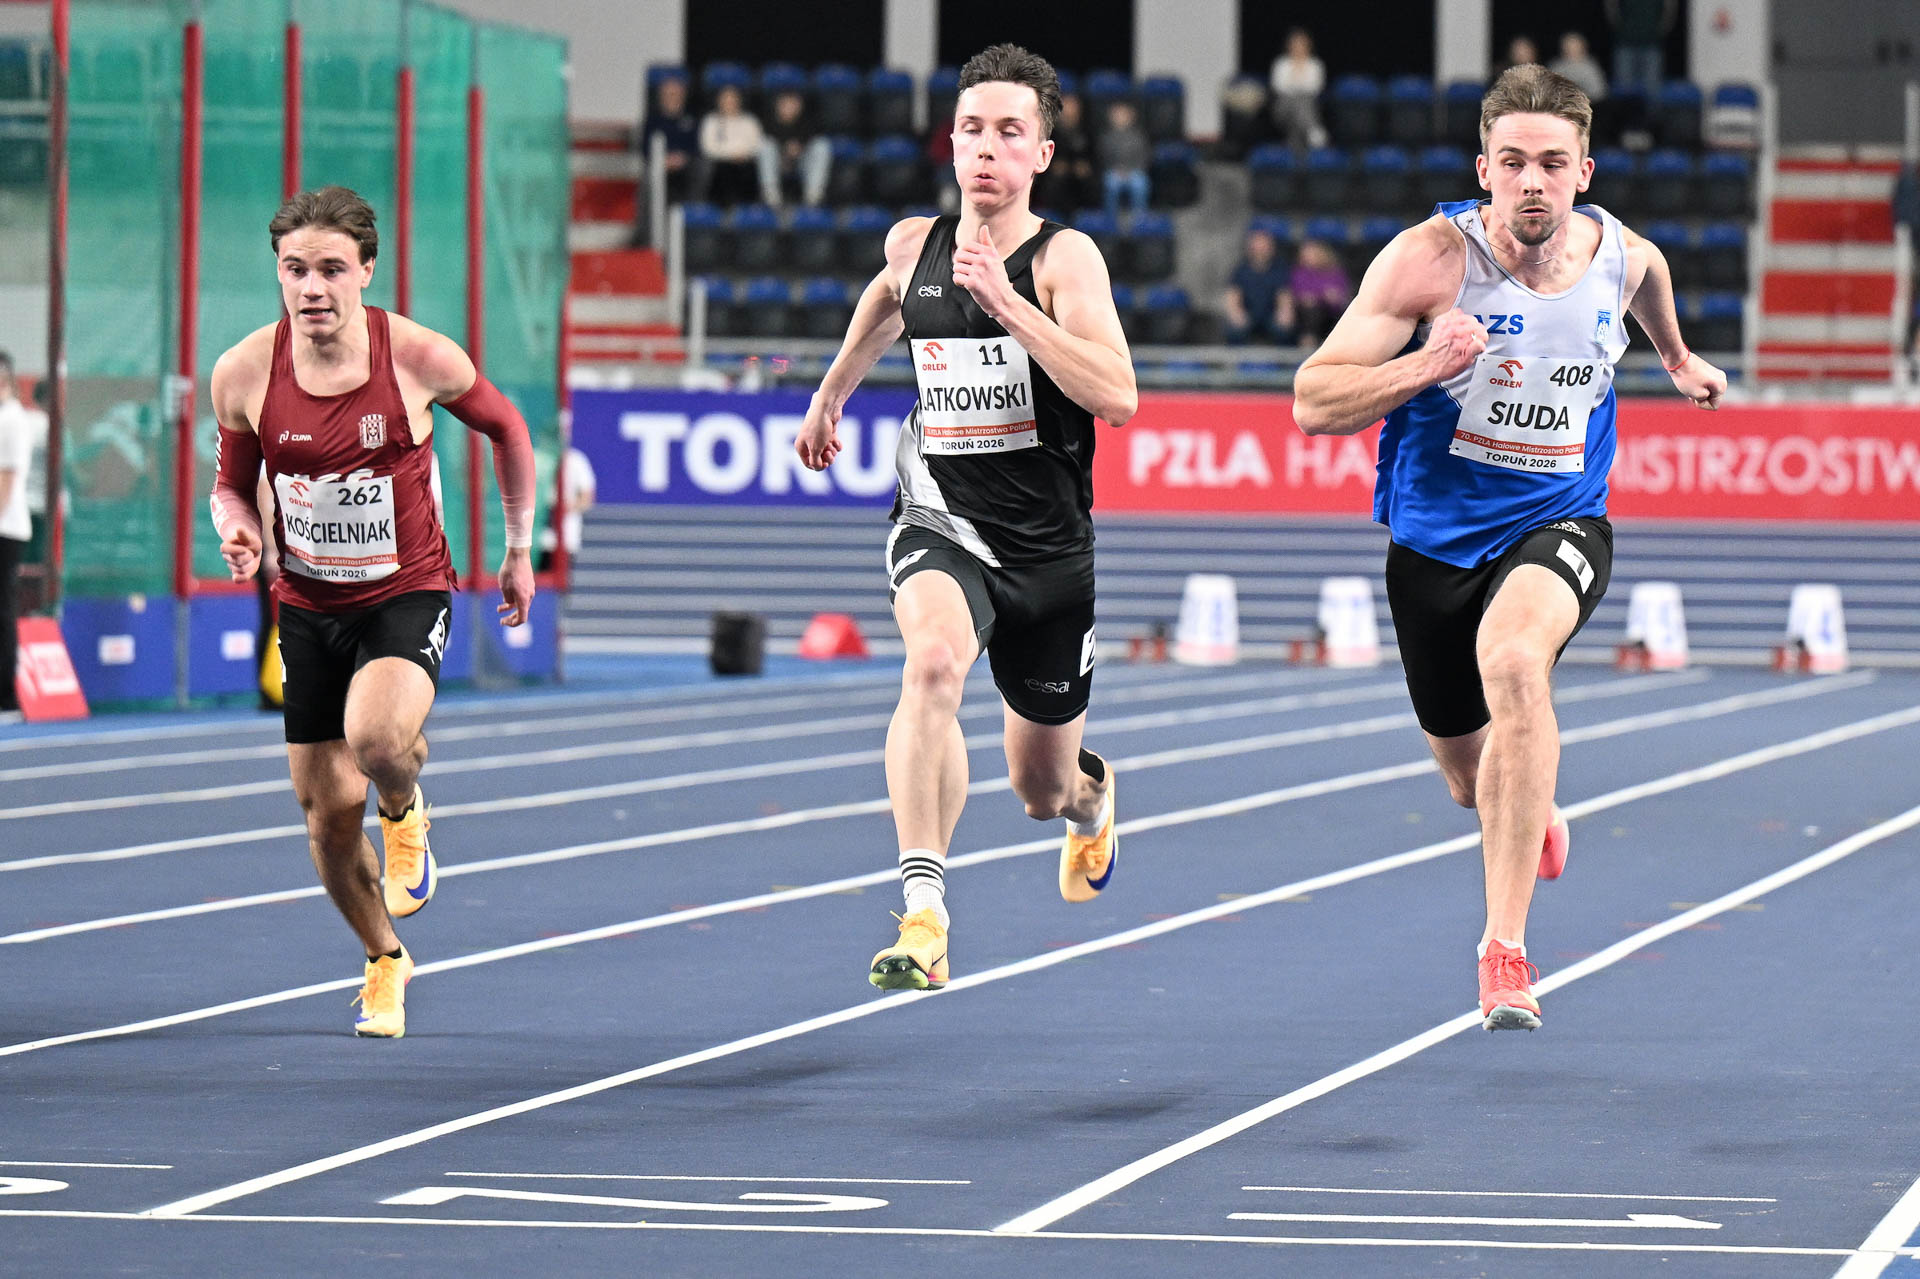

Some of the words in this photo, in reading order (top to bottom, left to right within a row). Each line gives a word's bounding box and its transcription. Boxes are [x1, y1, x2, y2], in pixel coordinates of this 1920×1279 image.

[918, 284, 942, 297] esa
[978, 343, 1007, 366] 11
[922, 363, 947, 371] ORLEN
[1489, 377, 1523, 388] ORLEN
[1550, 365, 1593, 387] 408
[1487, 401, 1570, 431] SIUDA
[965, 426, 1008, 435] Mistrzostwa
[1010, 423, 1031, 431] Polski
[941, 438, 974, 450] TORUŃ
[977, 438, 1005, 449] 2026
[1460, 432, 1472, 440] 70.
[1473, 436, 1491, 446] PZLA
[1492, 440, 1520, 451] Halowe
[1522, 446, 1564, 455] Mistrzostwa
[1129, 429, 1273, 488] PZLA
[1485, 452, 1527, 466] TORUŃ
[1529, 458, 1557, 468] 2026
[338, 484, 382, 506] 262
[289, 497, 313, 509] ORLEN
[285, 513, 391, 544] KOŚCIELNIAK
[331, 557, 371, 566] Mistrzostwa
[372, 555, 393, 563] Polski
[306, 565, 339, 577] TORUŃ
[341, 569, 367, 578] 2026
